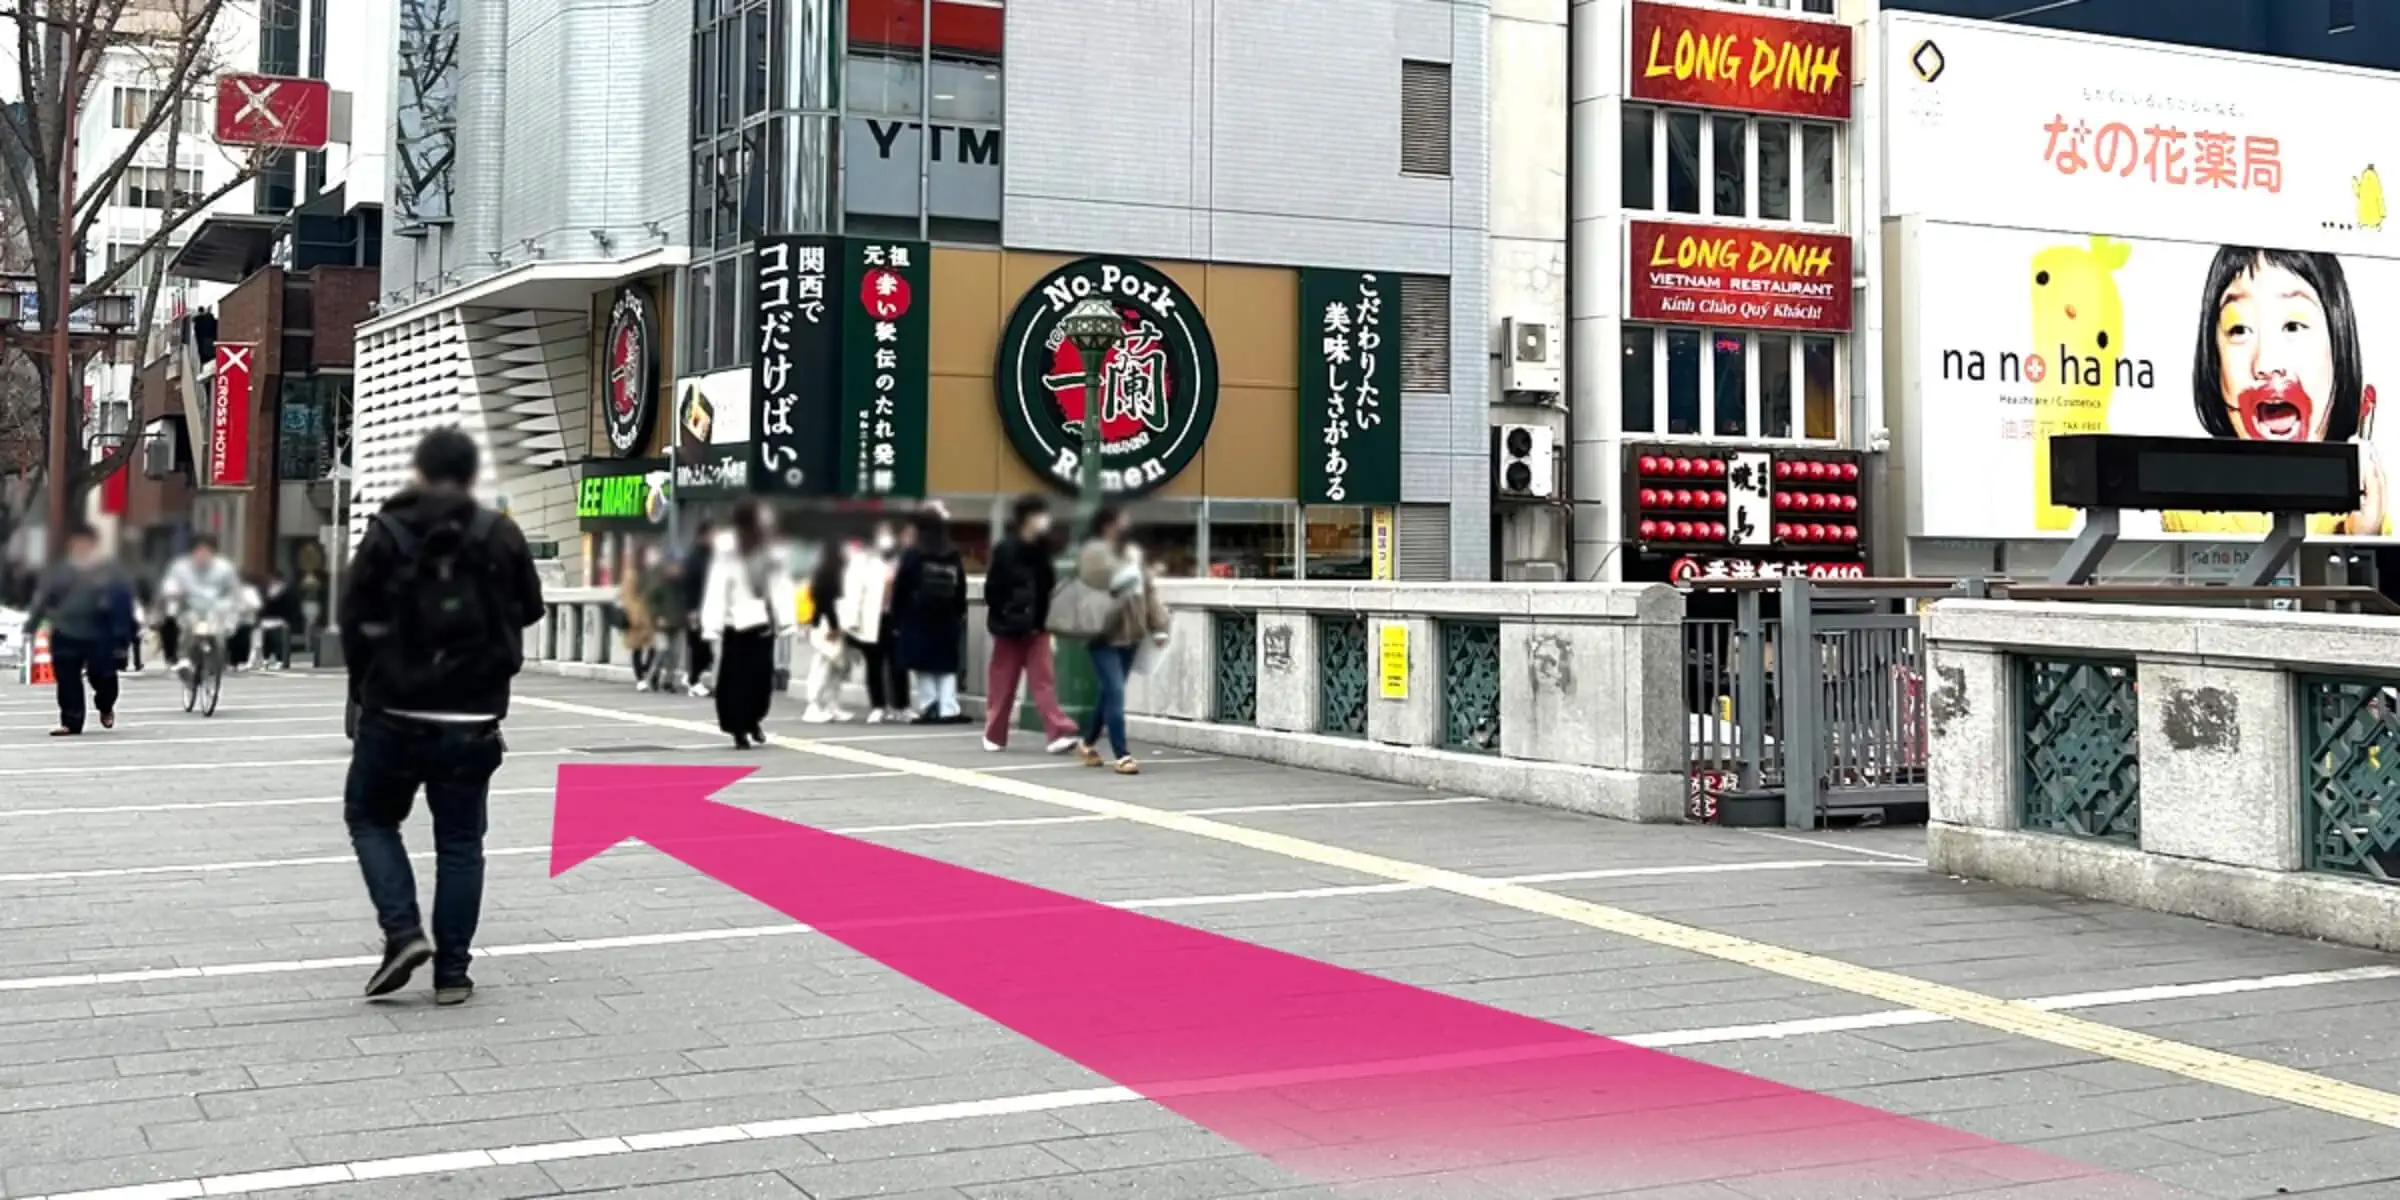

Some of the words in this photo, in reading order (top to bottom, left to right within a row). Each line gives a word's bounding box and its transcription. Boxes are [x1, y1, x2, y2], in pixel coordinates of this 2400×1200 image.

[1644, 25, 1742, 87] LONG
[1750, 37, 1843, 94] DINH
[866, 119, 1000, 165] YTM
[2043, 112, 2282, 193] なの花薬局
[863, 245, 910, 266] 元祖
[1650, 234, 1740, 271] LONG
[1748, 241, 1833, 276] DINH
[798, 247, 825, 323] 関西で
[1043, 275, 1091, 311] No
[1101, 265, 1176, 318] Pork
[1650, 272, 1720, 289] VIETNAM
[1731, 278, 1834, 295] RESTAURANT
[1661, 296, 1695, 312] Kính
[1740, 302, 1770, 319] Quý
[1773, 304, 1822, 320] Khách!
[760, 242, 803, 487] ココだけばい。
[1356, 273, 1381, 430] こだわりたい
[217, 375, 229, 427] CROSS
[1323, 301, 1351, 501] 美味しさがある
[214, 430, 227, 480] HOTEL
[576, 477, 601, 517] LEE
[601, 475, 643, 516] MART
